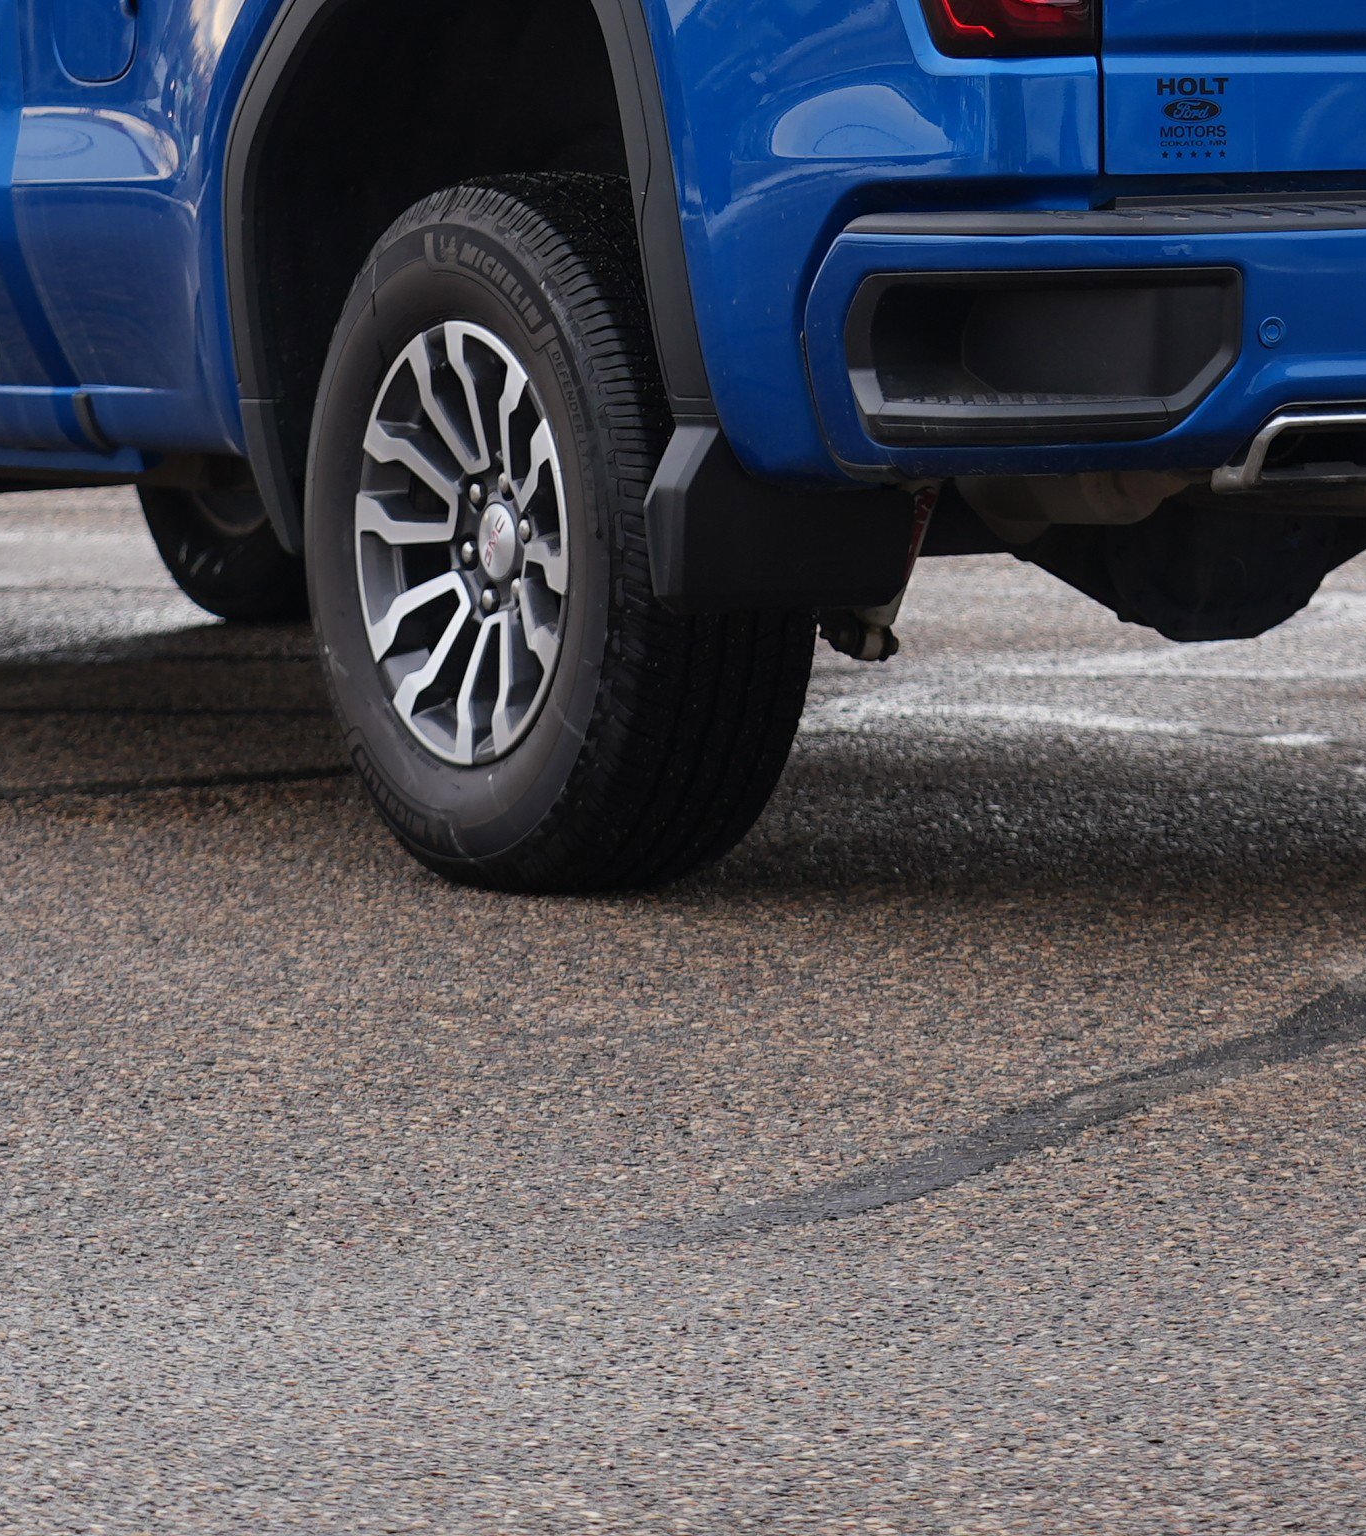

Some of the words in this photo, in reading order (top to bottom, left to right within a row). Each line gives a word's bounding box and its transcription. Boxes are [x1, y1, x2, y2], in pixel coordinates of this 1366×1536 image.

[1156, 77, 1229, 96] HOLT
[1160, 125, 1227, 138] MOTORS
[458, 242, 543, 330] MICHELIN
[551, 350, 584, 434] DEFENDER
[484, 514, 506, 568] GMC
